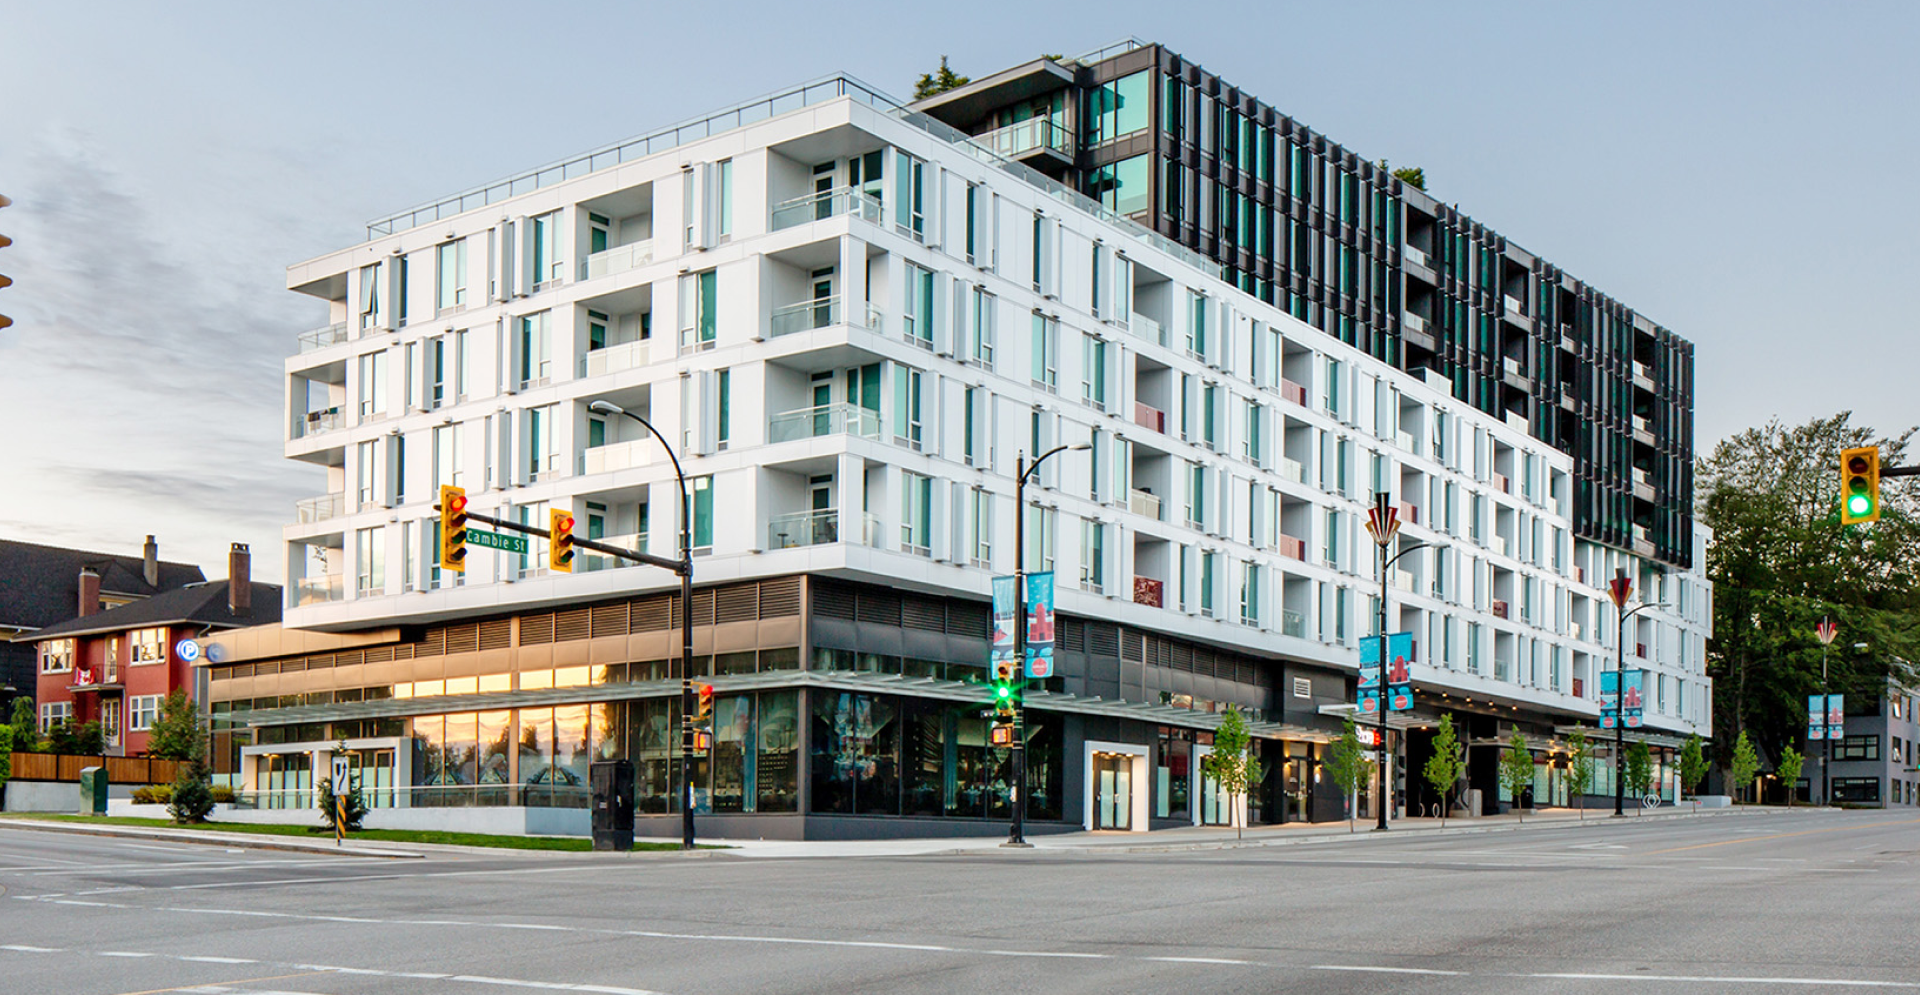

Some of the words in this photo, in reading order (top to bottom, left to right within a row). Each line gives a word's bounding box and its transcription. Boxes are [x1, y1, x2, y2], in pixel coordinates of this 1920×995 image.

[466, 530, 509, 549] Cambie
[513, 539, 525, 551] St
[185, 644, 195, 657] P
